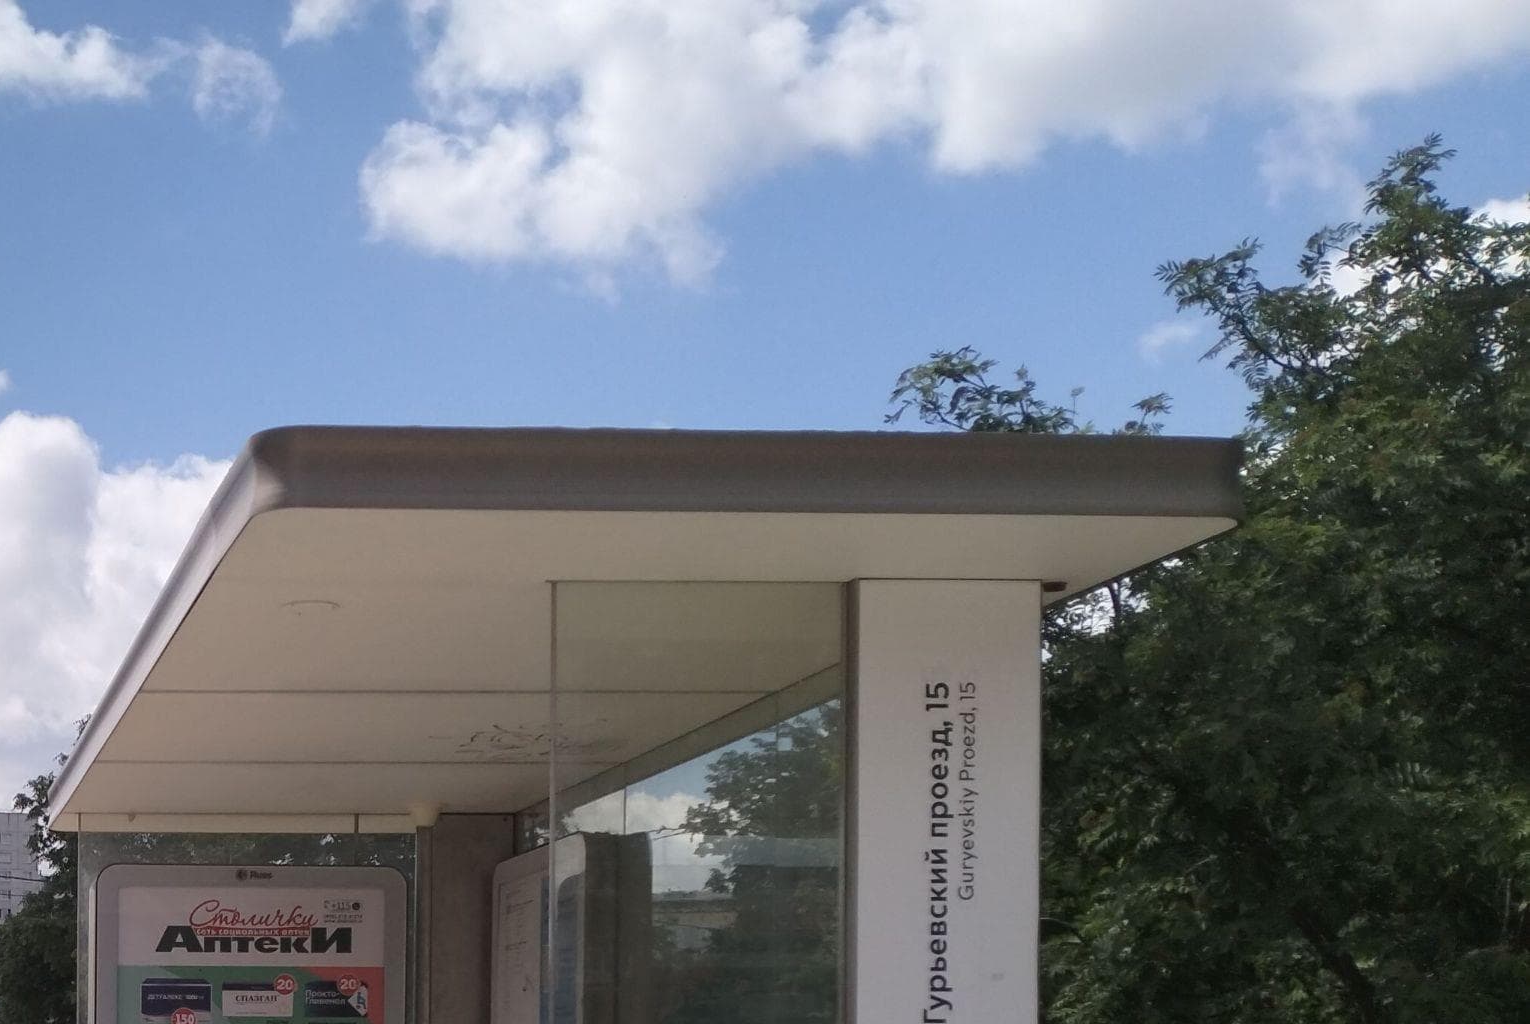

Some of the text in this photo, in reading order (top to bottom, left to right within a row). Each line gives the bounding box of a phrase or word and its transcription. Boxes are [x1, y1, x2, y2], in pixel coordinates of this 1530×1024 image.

[957, 681, 980, 901] Guryevskiy Proezd, 15
[923, 681, 955, 1024] Гурьевский проезд, 15
[276, 980, 293, 990] 20
[339, 980, 357, 990] 20
